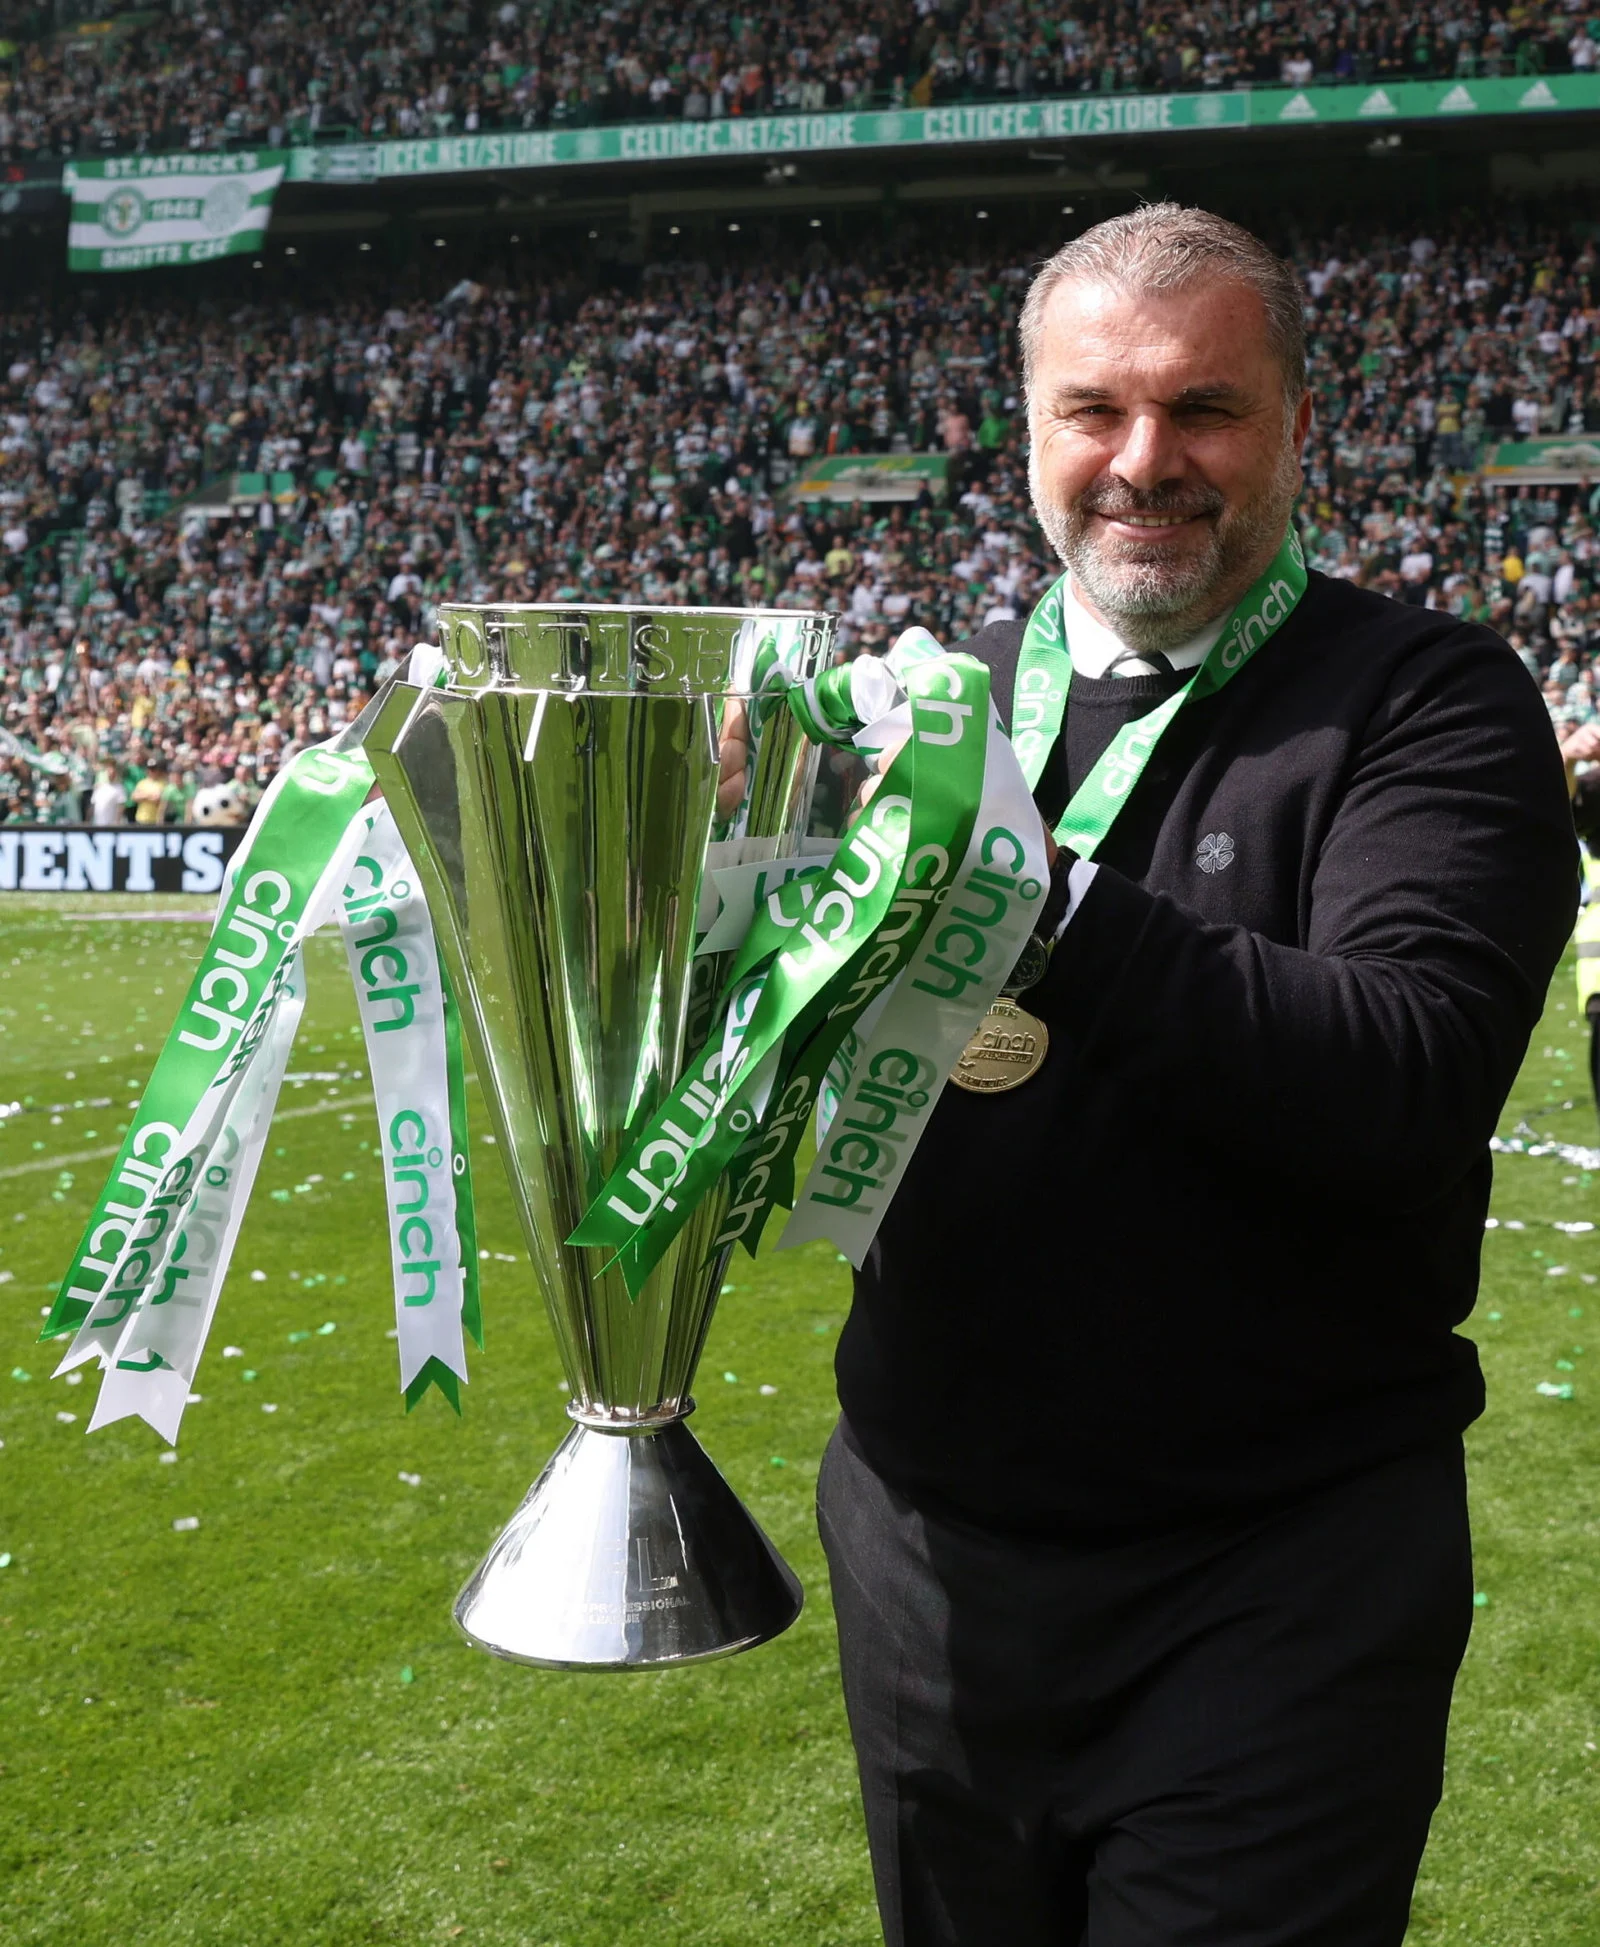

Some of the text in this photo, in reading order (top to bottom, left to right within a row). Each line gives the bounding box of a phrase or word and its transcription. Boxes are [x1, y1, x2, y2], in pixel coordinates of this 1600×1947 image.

[1221, 578, 1296, 669] cinch
[178, 869, 297, 1052] cinch
[341, 855, 421, 1034] cinch
[910, 825, 1042, 999] cinch
[982, 1024, 1036, 1053] cinch
[389, 1108, 443, 1308] cinch
[716, 1075, 810, 1245] cinch
[809, 1047, 930, 1216] cinch
[90, 1155, 193, 1329] cinch
